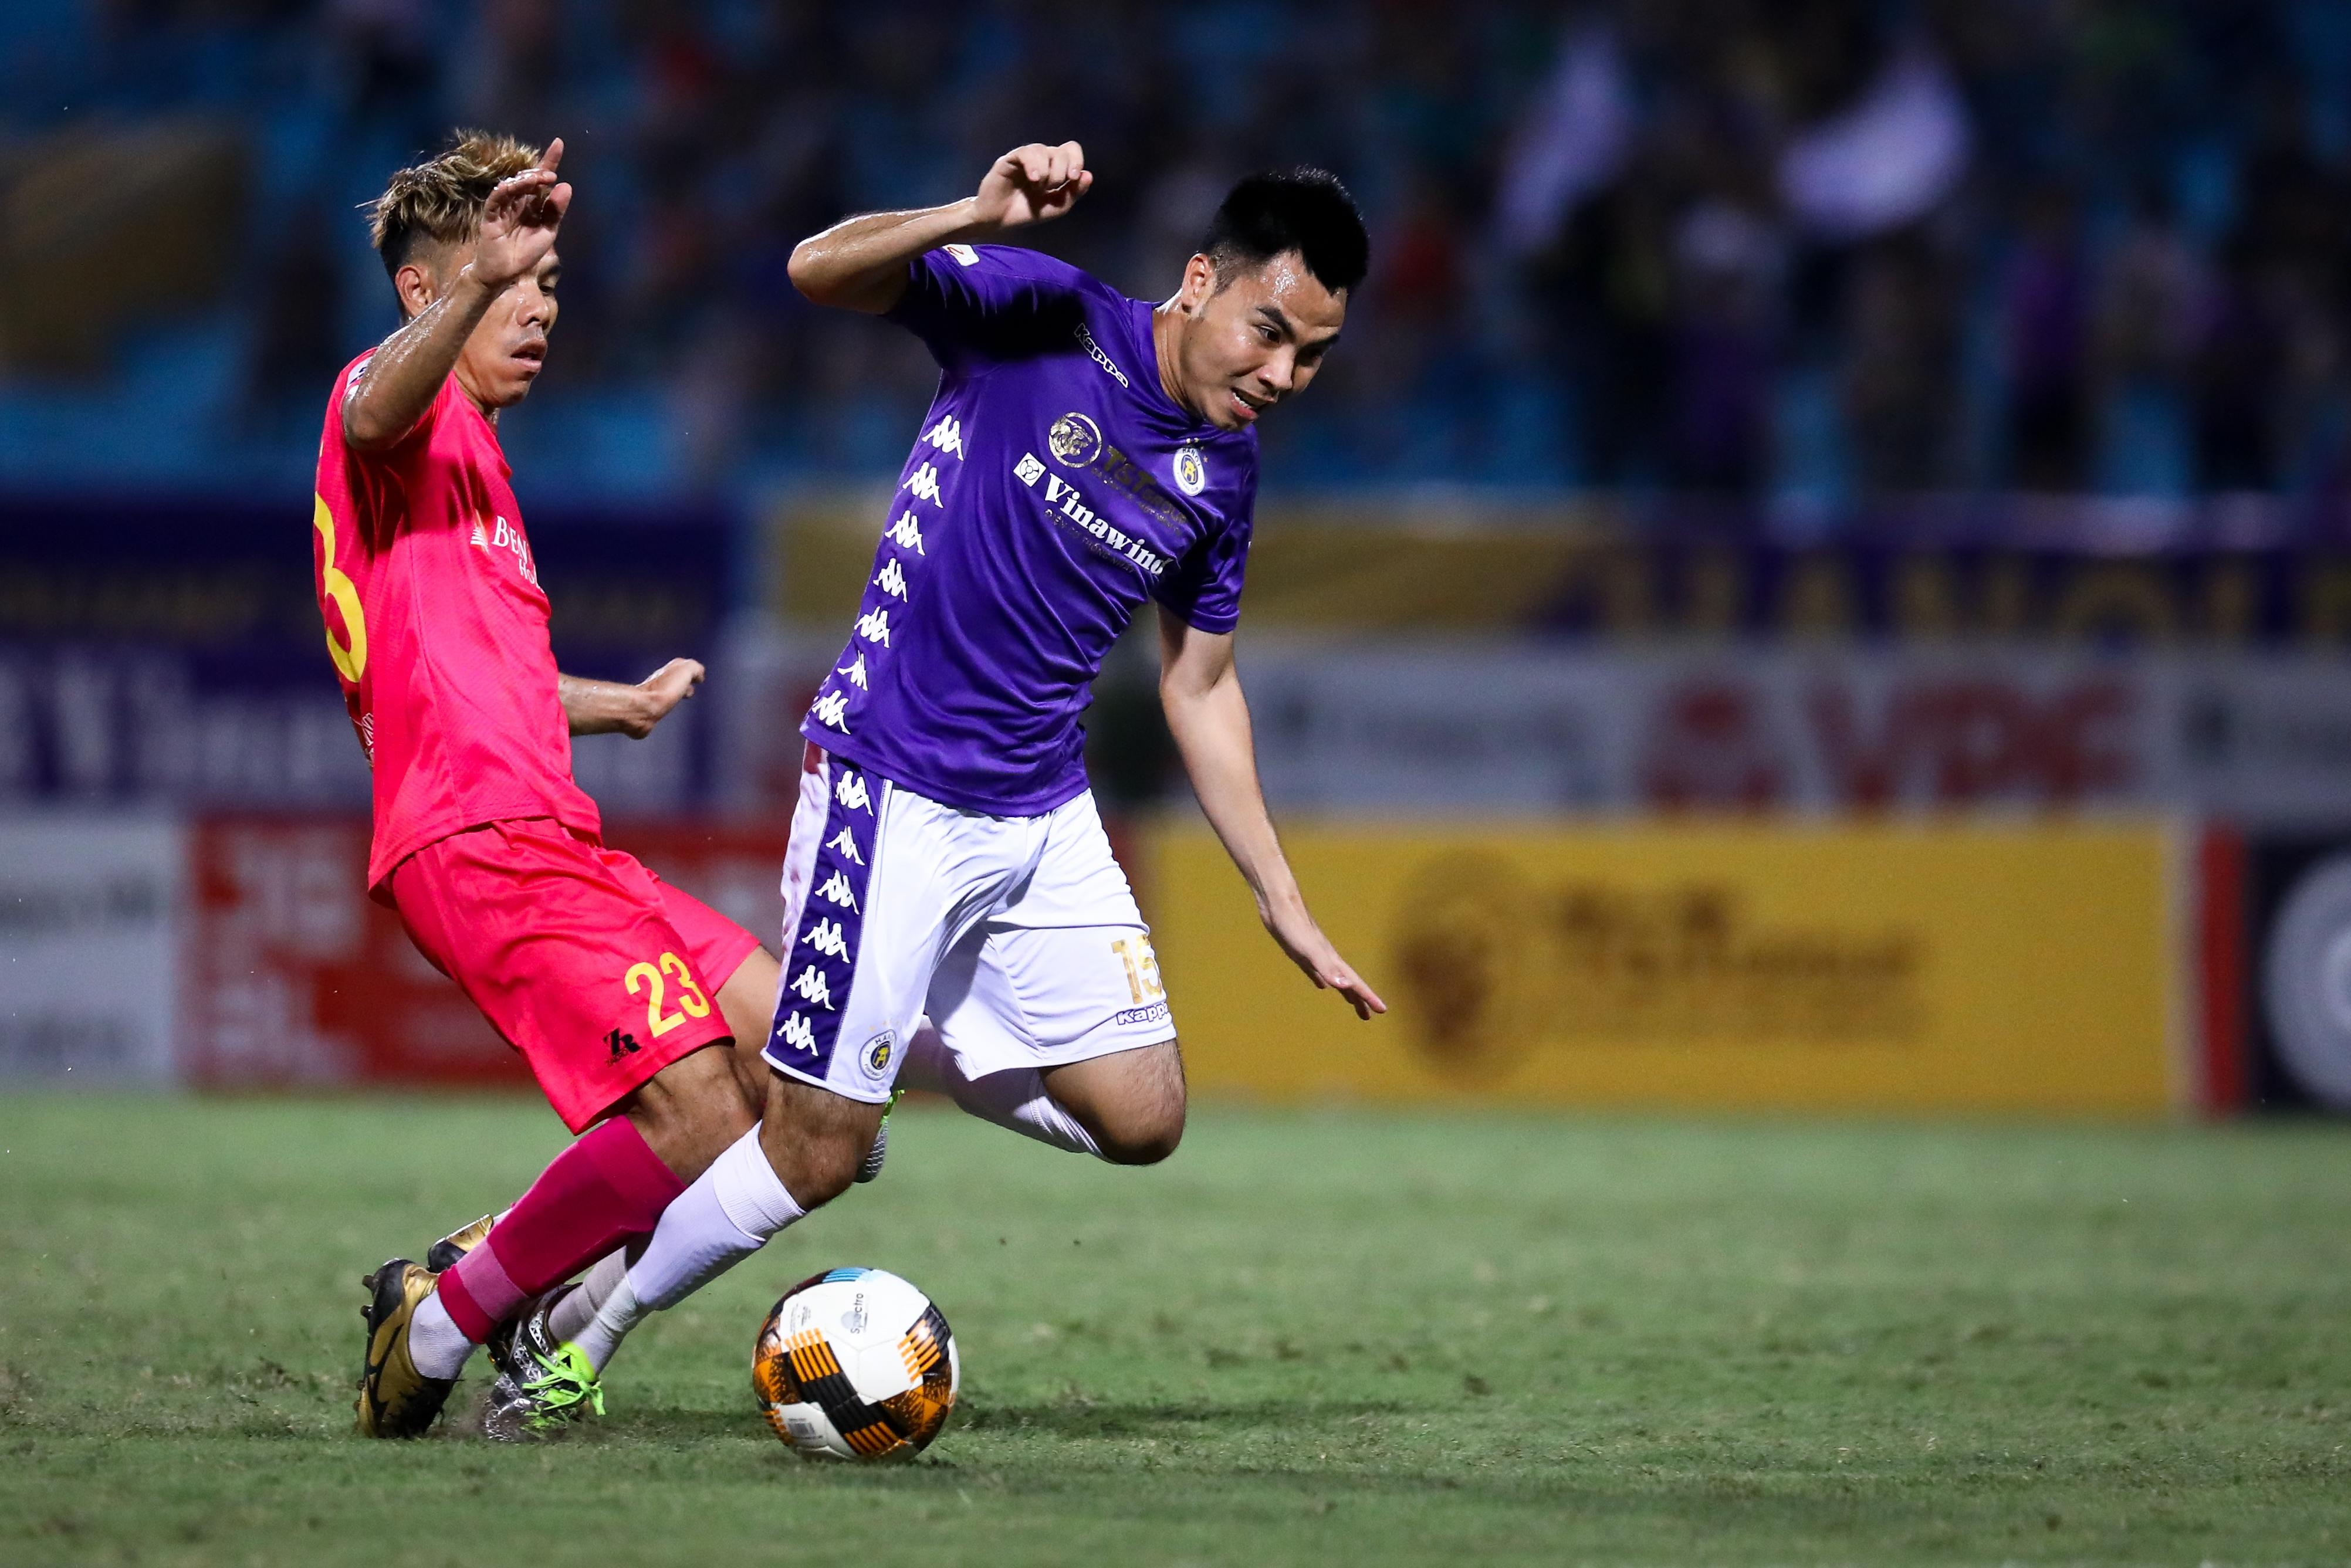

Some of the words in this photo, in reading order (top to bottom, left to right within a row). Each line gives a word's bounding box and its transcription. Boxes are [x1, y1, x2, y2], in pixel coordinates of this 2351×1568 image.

[1074, 323, 1128, 388] Kappa
[624, 951, 711, 1038] 23
[1111, 933, 1162, 1004] 15
